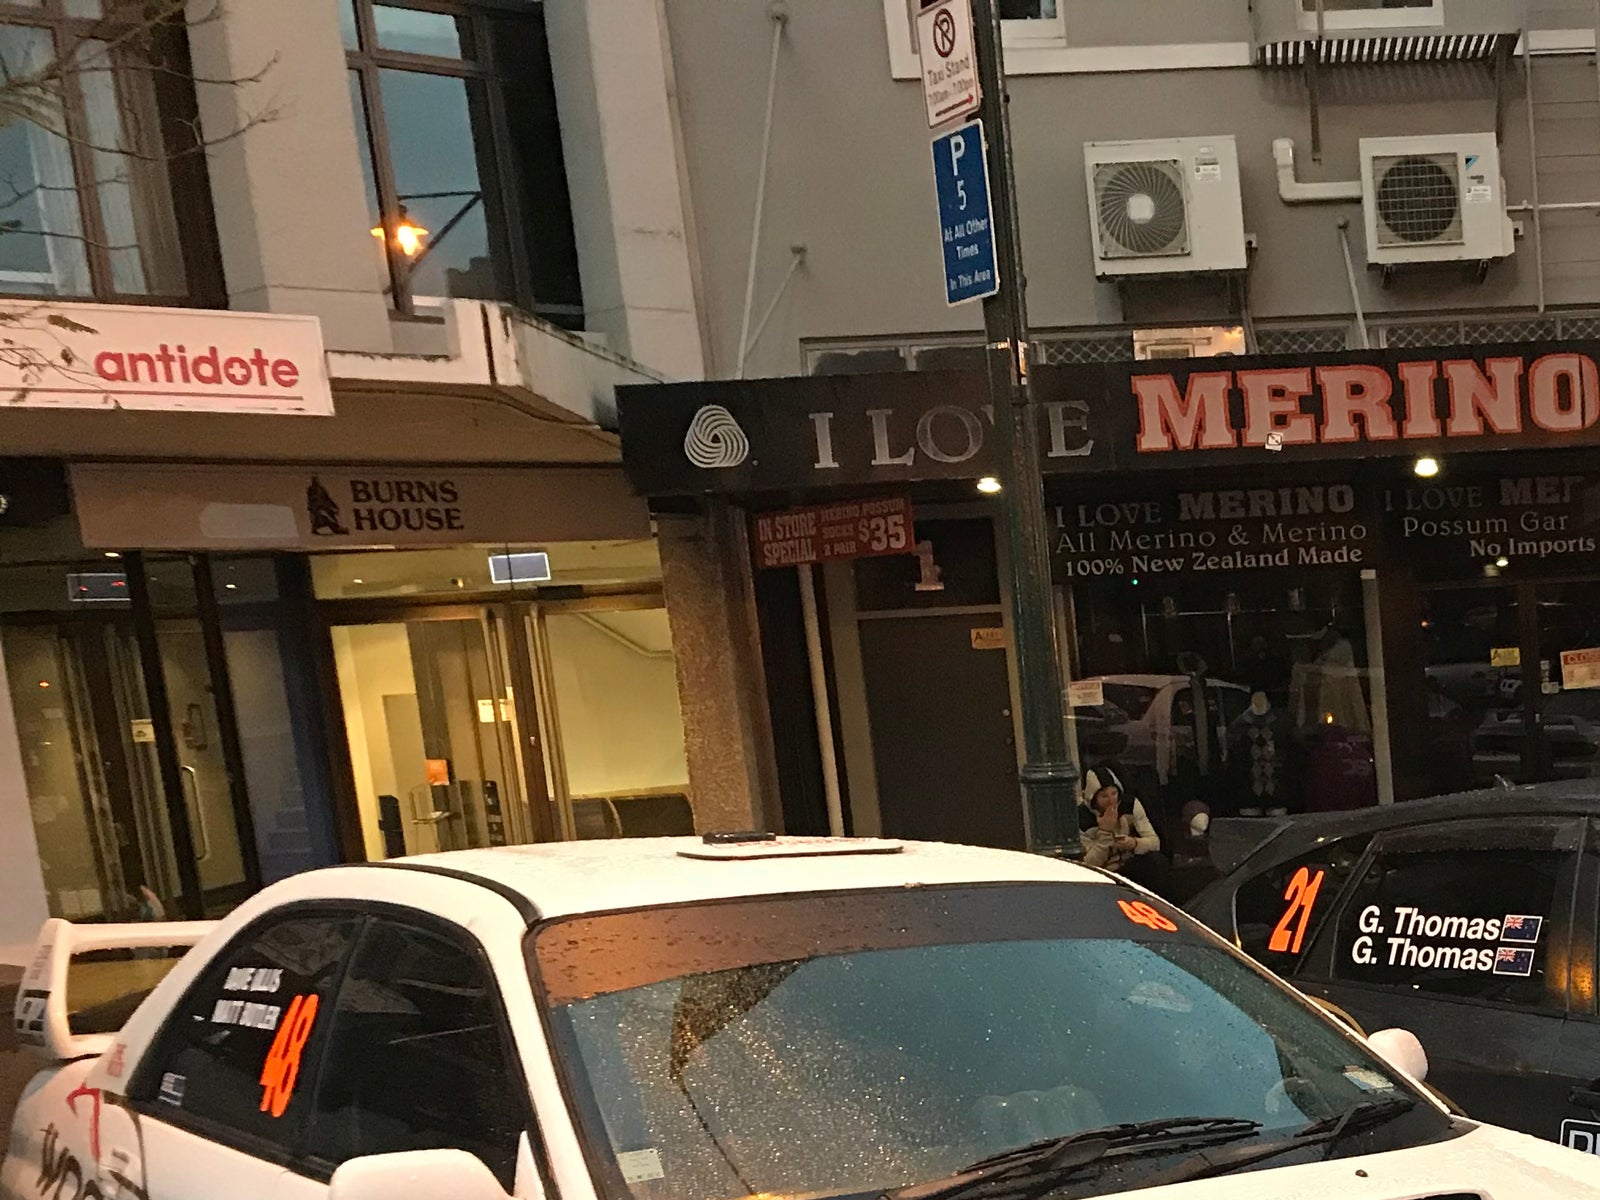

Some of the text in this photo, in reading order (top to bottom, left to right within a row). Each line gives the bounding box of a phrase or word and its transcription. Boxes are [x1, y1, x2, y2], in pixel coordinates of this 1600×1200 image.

[950, 134, 966, 176] P
[956, 180, 967, 211] 5
[944, 218, 989, 243] At All Other
[956, 243, 980, 260] Times
[958, 272, 972, 289] This
[973, 268, 991, 284] Area
[94, 342, 300, 389] antidote
[808, 352, 1600, 470] I LOE MERINO
[350, 479, 458, 504] BURNS
[1055, 483, 1355, 528] I LOVE MERINO
[1405, 485, 1483, 512] LOVE
[354, 507, 465, 533] HOUSE
[775, 511, 817, 540] STORE
[858, 514, 906, 551] $35
[1402, 515, 1509, 539] Possum
[763, 536, 817, 567] SPECIAL
[1055, 520, 1368, 554] All Merino & Merino
[1470, 535, 1597, 560] No Imports
[1064, 543, 1364, 578] 100% New Zealand Made
[1267, 866, 1325, 954] 21
[1358, 905, 1501, 941] G. Thomas
[1351, 936, 1494, 972] G. Thomas
